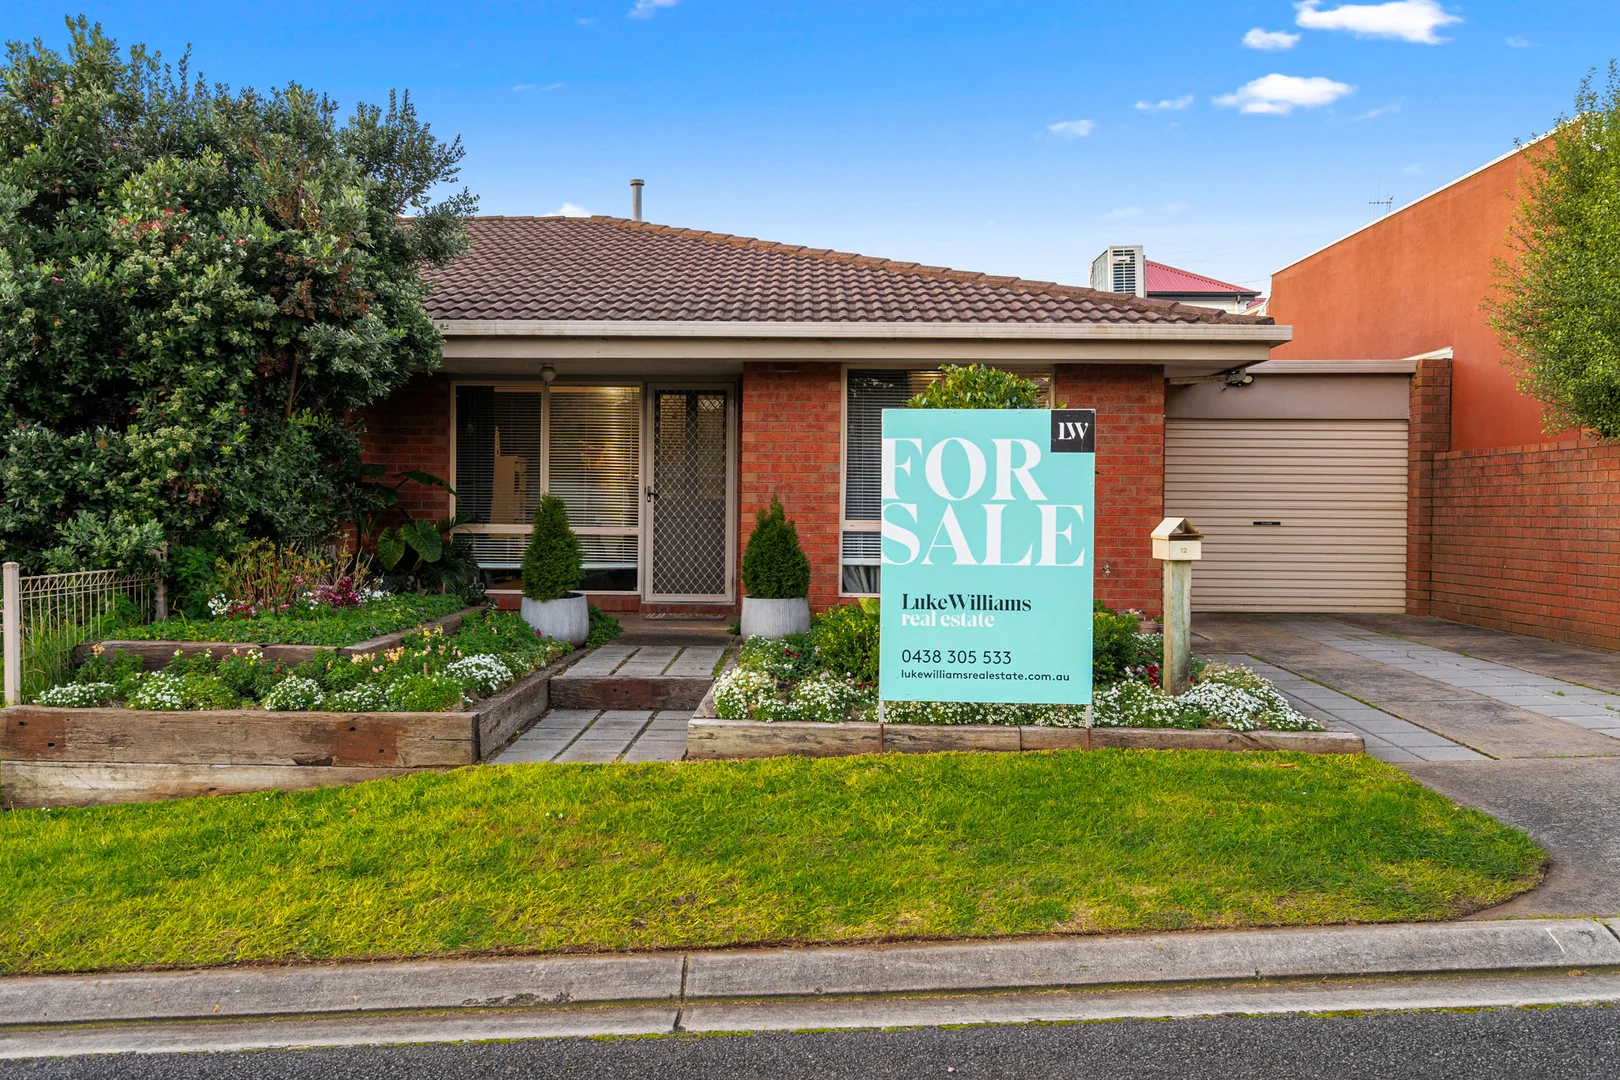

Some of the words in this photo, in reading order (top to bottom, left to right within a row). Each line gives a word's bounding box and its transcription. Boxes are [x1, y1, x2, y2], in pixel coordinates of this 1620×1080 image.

[1058, 422, 1089, 440] LW
[882, 437, 1048, 500] FOR
[881, 503, 1084, 566] SALE
[901, 612, 936, 626] real
[940, 612, 995, 627] estate
[901, 649, 942, 663] 0438
[947, 651, 977, 664] 305
[982, 651, 1012, 664] 533
[901, 669, 1070, 681] lukewilliamsrealestate.com.au
